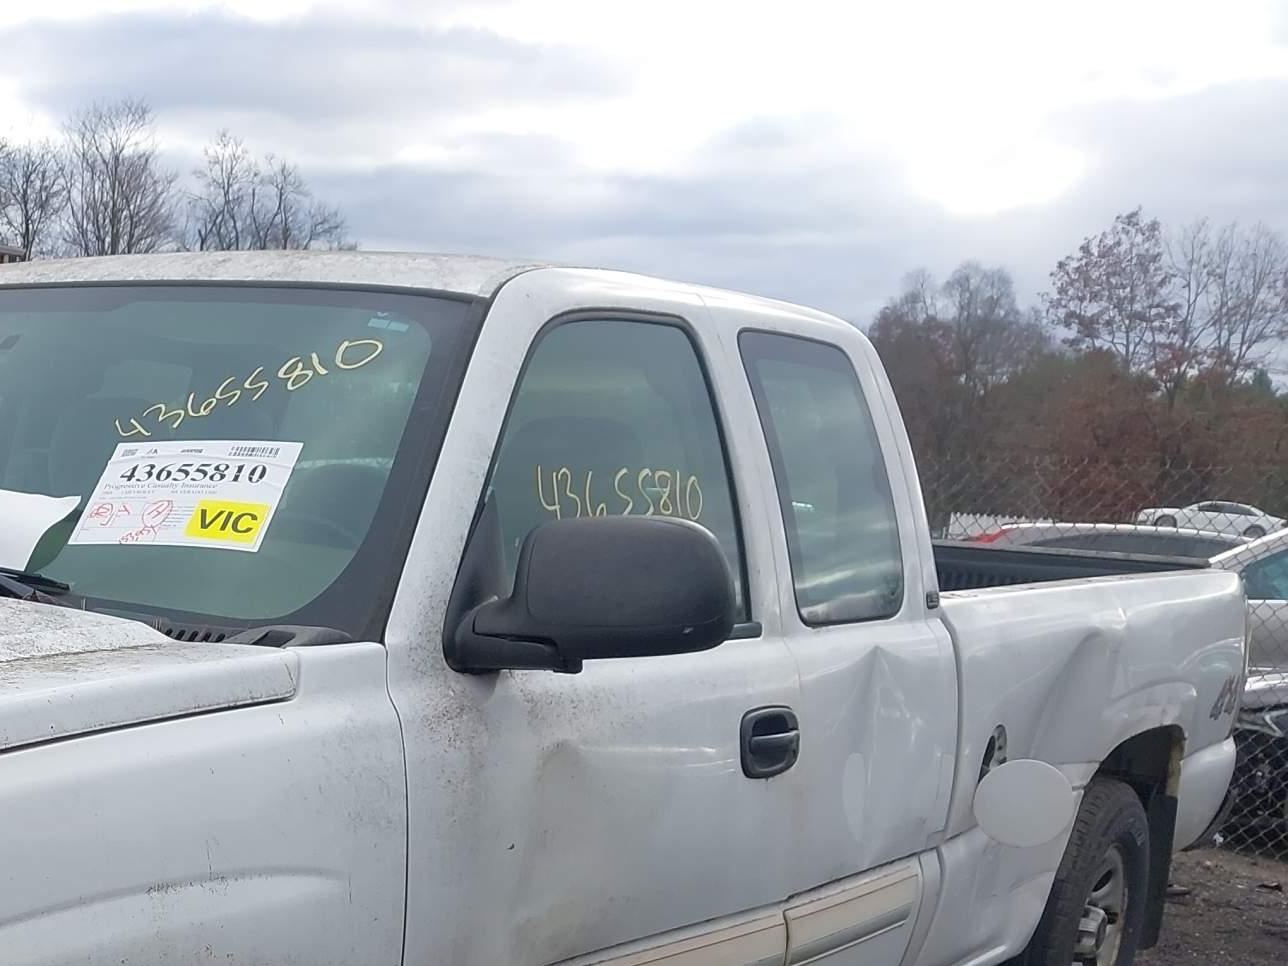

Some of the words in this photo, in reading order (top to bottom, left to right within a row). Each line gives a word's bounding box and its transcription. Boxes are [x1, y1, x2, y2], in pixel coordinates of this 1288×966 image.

[114, 339, 383, 437] 43655810
[119, 462, 268, 484] 43655810
[537, 463, 704, 521] 43655810
[200, 508, 259, 534] VIC
